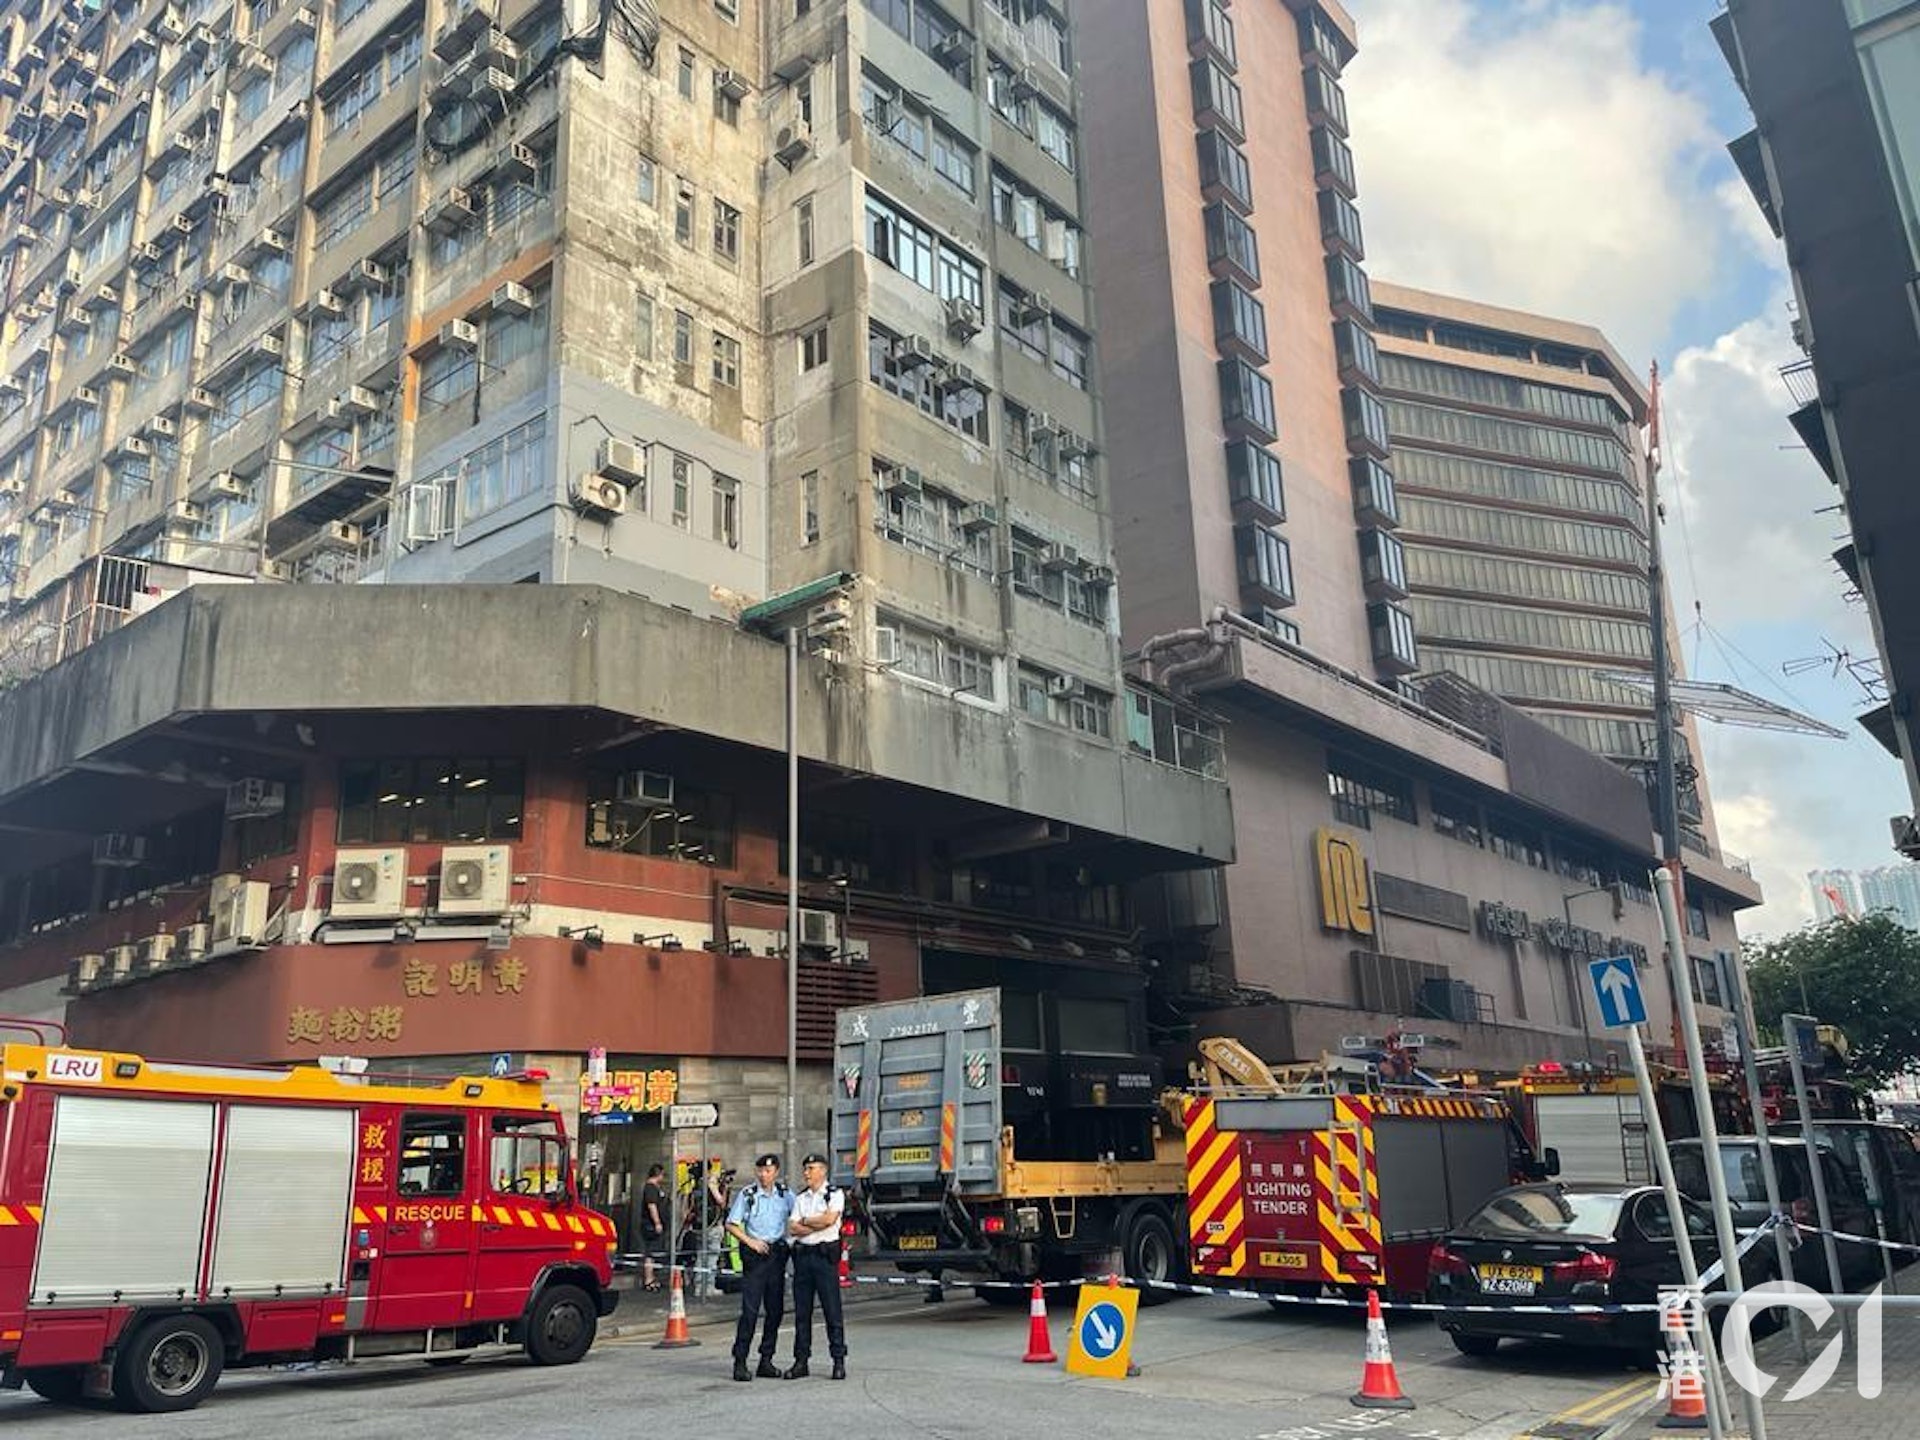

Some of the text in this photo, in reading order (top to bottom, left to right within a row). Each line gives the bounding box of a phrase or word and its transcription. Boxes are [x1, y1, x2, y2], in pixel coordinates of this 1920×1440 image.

[51, 1059, 98, 1077] LRU
[361, 1124, 387, 1182] 救援
[1246, 1182, 1312, 1197] LIGHTING
[395, 1205, 466, 1221] RESCUE
[1253, 1201, 1308, 1215] TENDER
